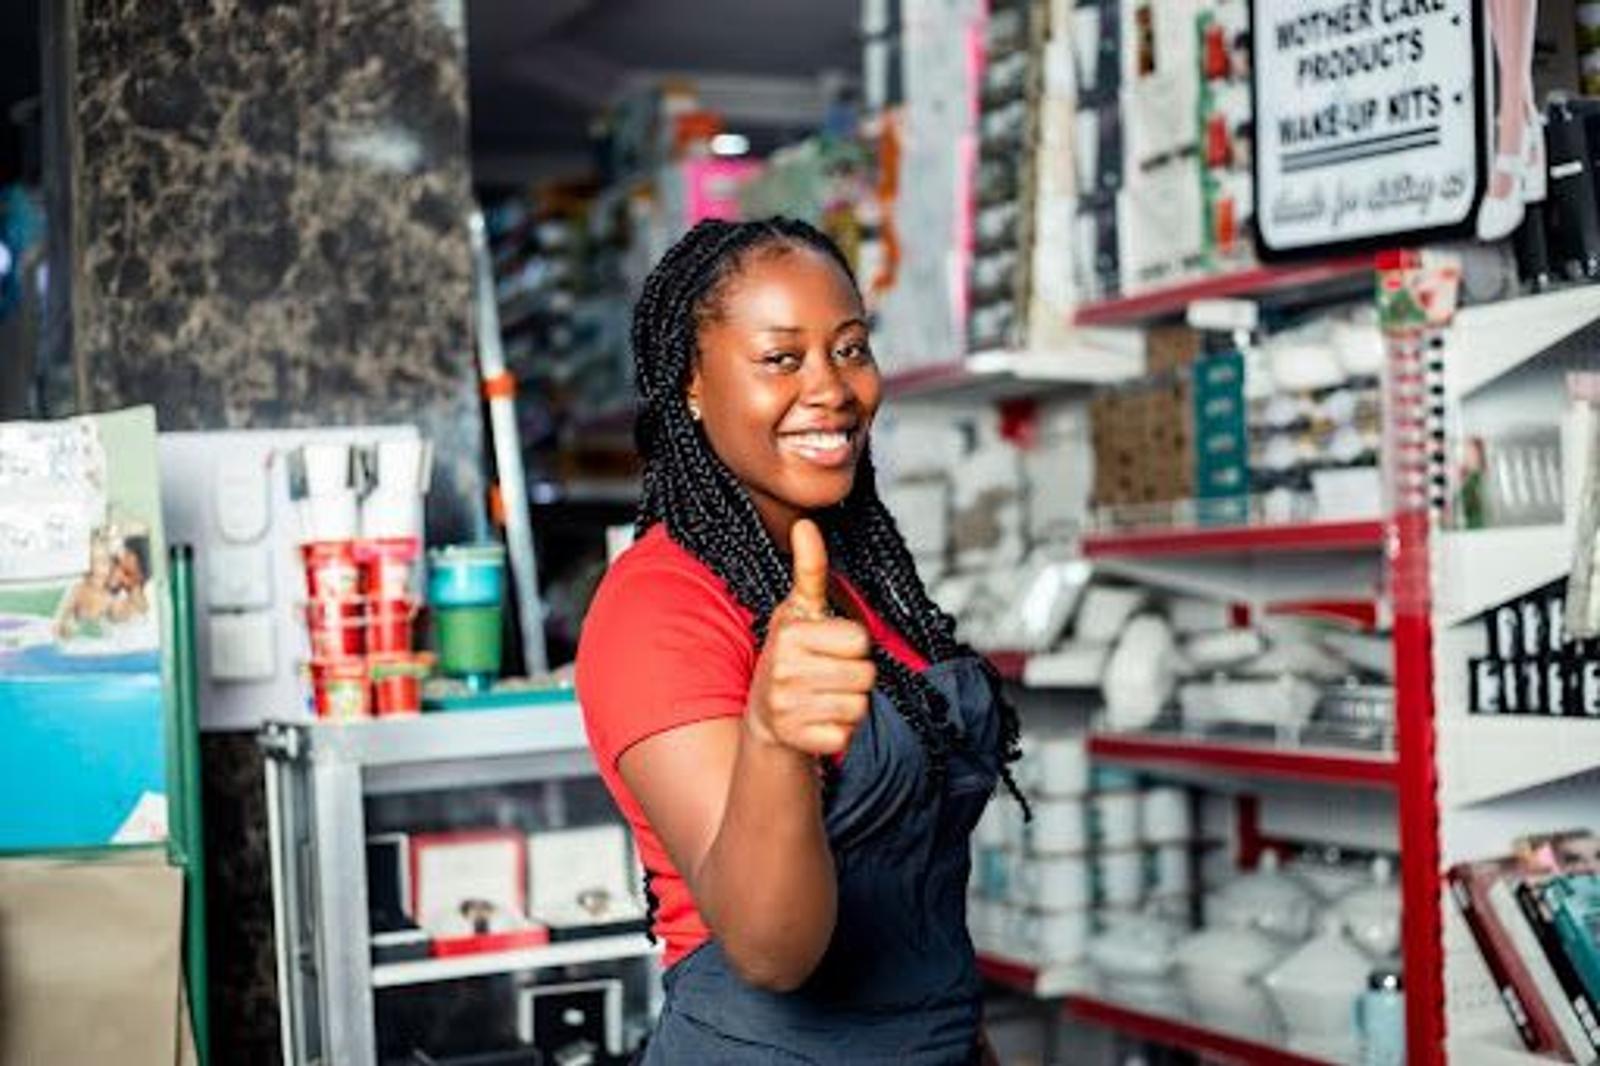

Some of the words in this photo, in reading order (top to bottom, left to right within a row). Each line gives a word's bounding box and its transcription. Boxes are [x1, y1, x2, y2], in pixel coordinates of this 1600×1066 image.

[1277, 0, 1372, 50] MOTHER
[1297, 29, 1424, 84] PRODUCTS
[1387, 84, 1442, 122] KITS
